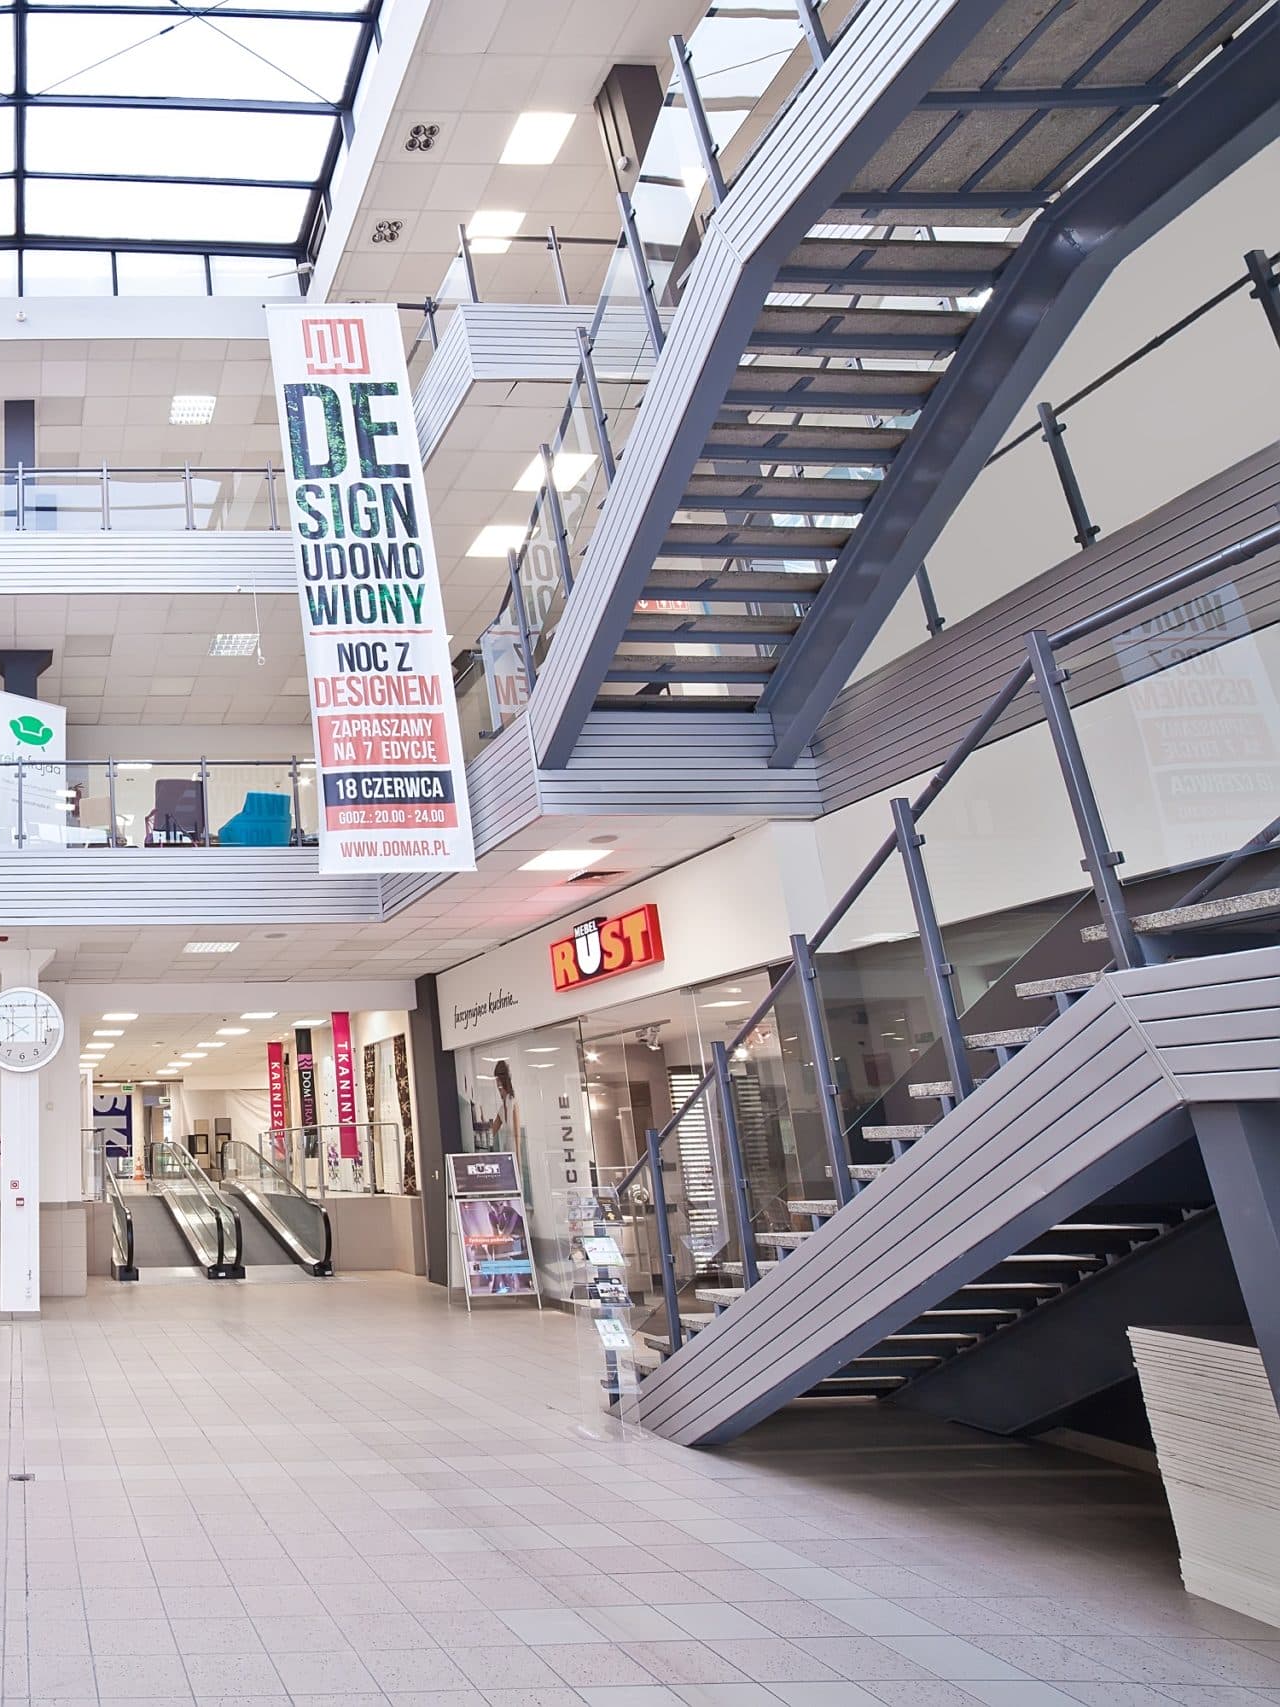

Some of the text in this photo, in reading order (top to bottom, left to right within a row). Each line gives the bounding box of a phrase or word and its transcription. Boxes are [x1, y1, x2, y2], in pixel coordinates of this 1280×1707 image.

[284, 382, 411, 480] DE
[295, 482, 419, 539] SIGN
[301, 542, 425, 581] UDOMO
[305, 583, 426, 625] WIONY
[337, 642, 413, 672] NOC Z
[314, 674, 443, 708] DESIGNEM
[331, 718, 432, 738] ZAPRASZAMY
[333, 740, 437, 762] NA 7 EDYCJĘ
[336, 776, 444, 799] 18 CZERWCA
[375, 810, 405, 823] 20.00
[415, 809, 445, 823] 24.00
[340, 840, 450, 858] WWW.DOMAR.PL
[574, 920, 598, 937] MEBEL
[552, 909, 648, 988] RUST
[337, 1041, 353, 1125] TKANINY
